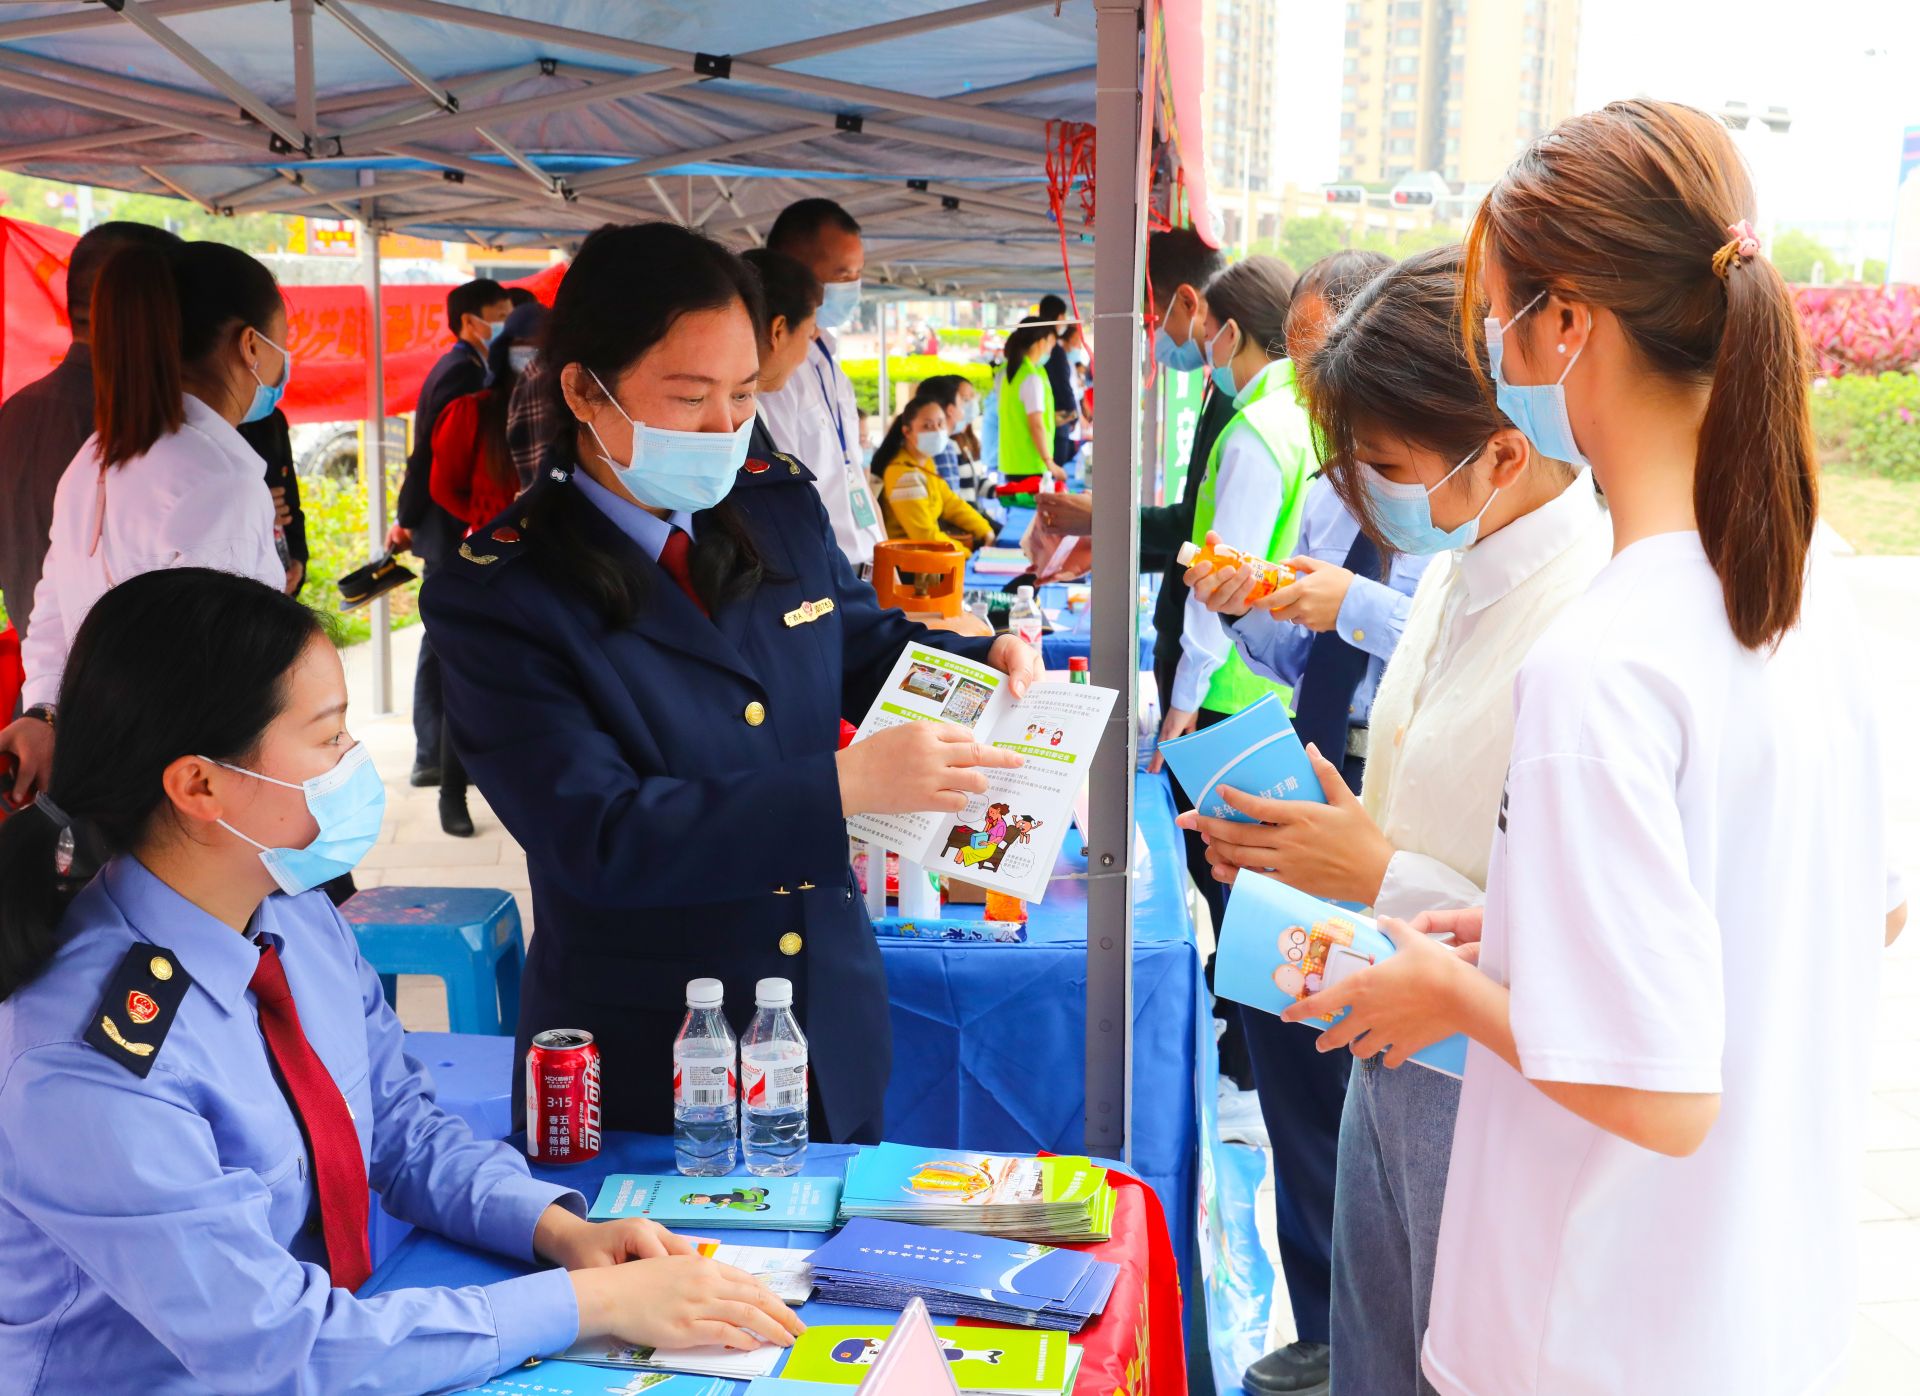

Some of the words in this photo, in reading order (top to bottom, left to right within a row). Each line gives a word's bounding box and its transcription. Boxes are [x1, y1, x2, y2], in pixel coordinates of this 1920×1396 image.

[1211, 775, 1299, 819] 老年权手册
